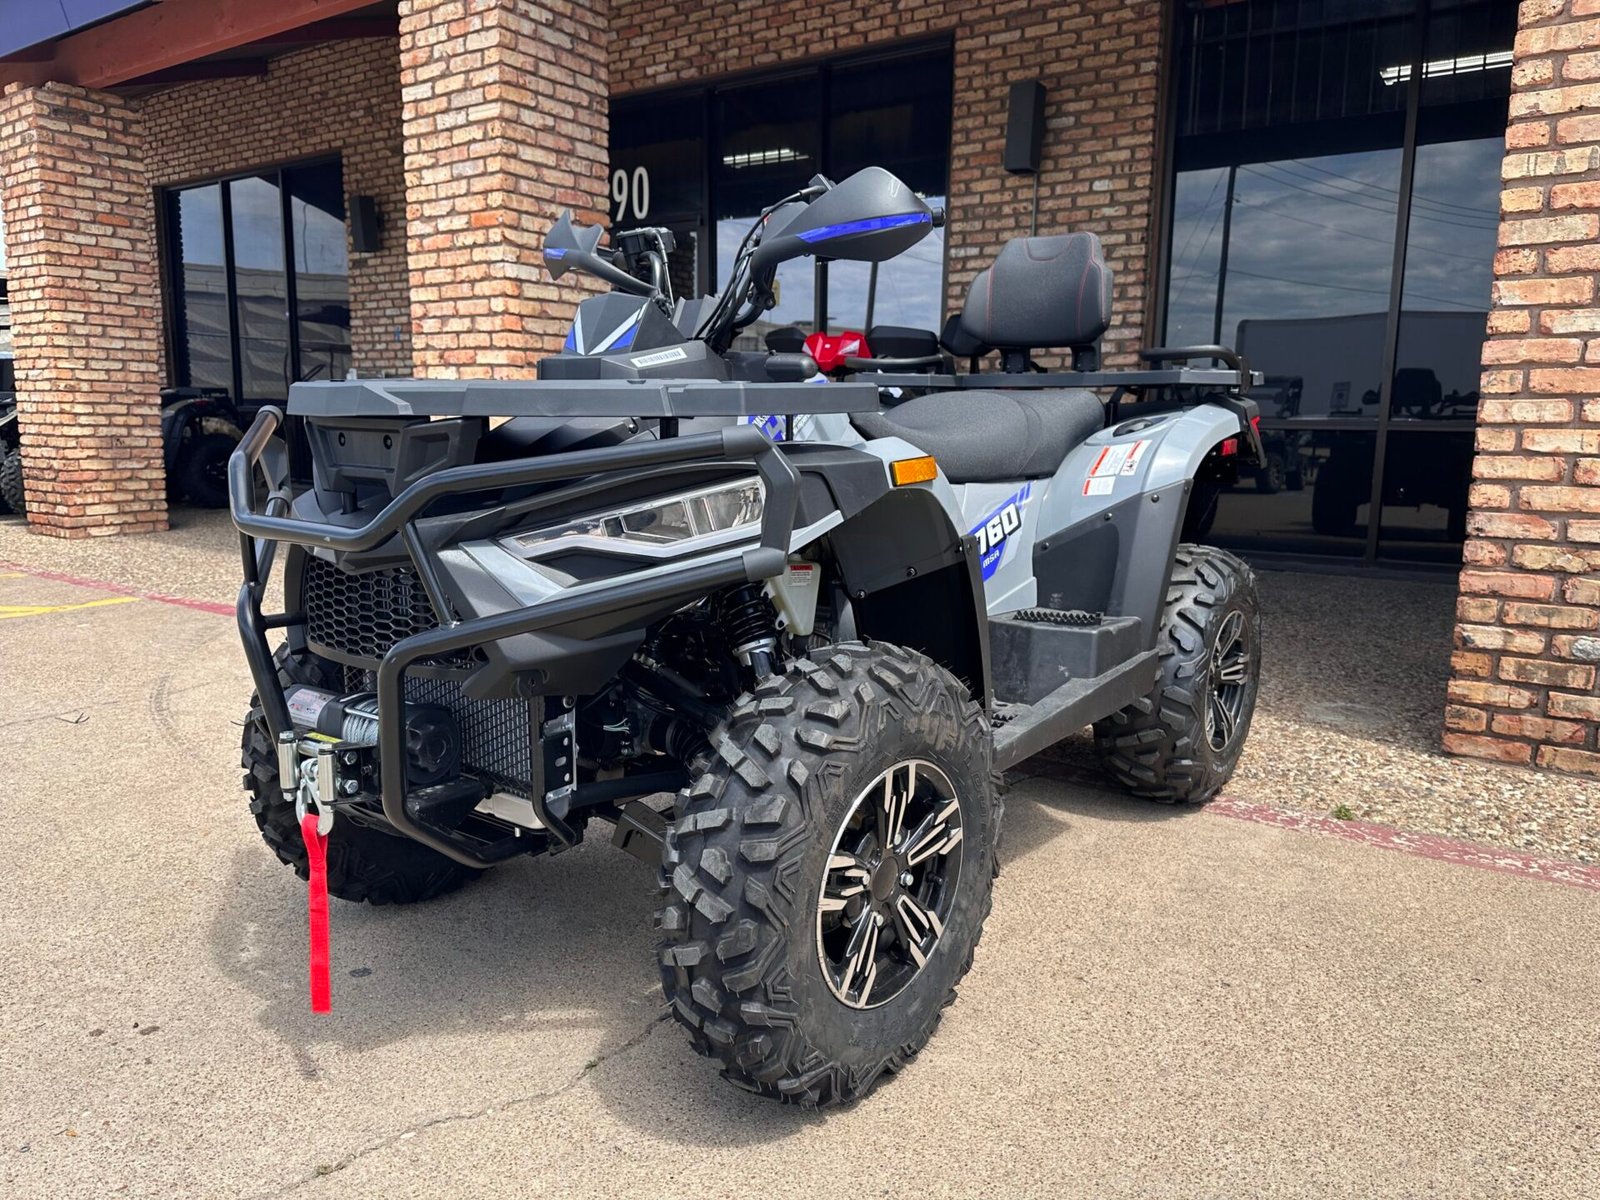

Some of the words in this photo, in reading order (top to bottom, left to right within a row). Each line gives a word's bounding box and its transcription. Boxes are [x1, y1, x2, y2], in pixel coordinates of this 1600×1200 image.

[612, 166, 649, 221] 90
[975, 502, 1020, 556] 760
[982, 549, 1000, 568] MSA
